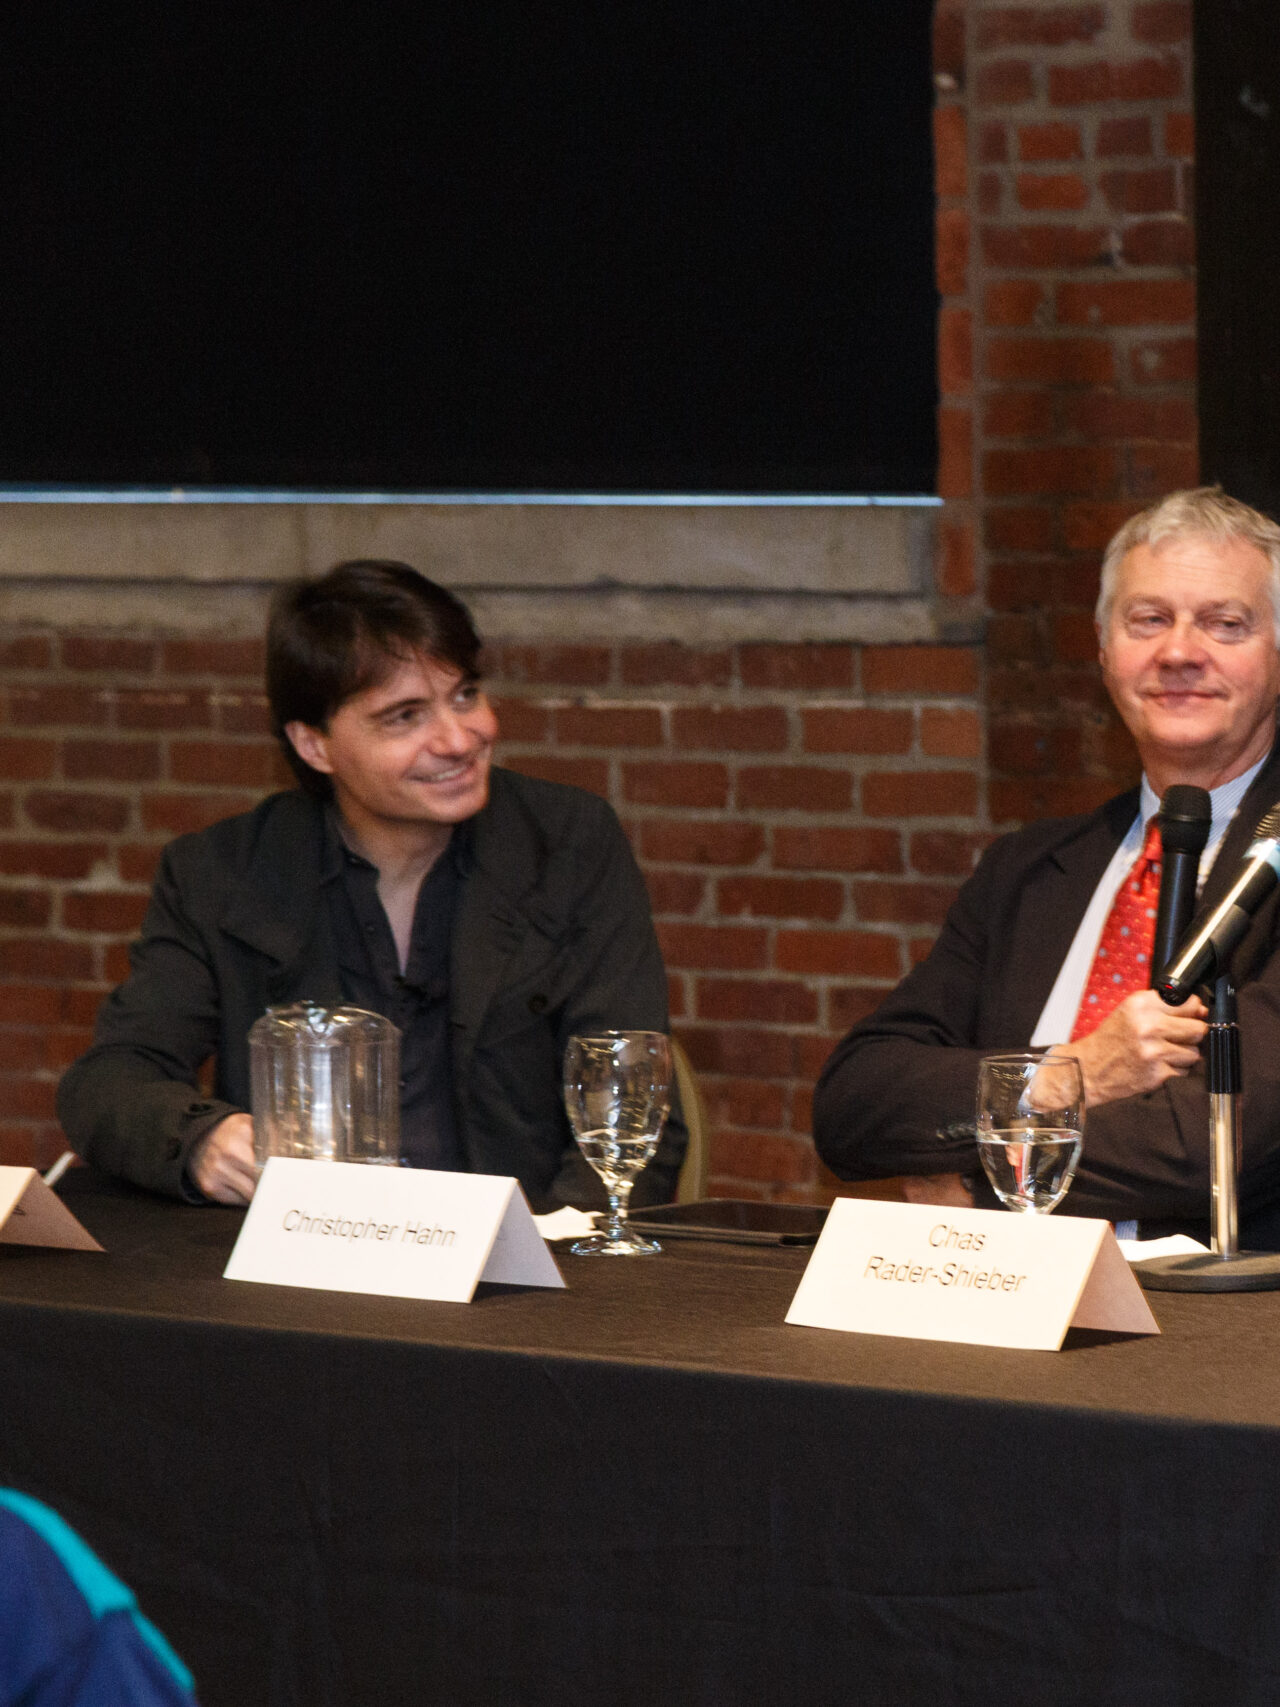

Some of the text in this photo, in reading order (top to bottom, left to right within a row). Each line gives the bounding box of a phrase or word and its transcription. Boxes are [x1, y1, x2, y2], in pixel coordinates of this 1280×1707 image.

[282, 1209, 457, 1247] Christopher Hahn
[928, 1224, 987, 1252] Chas
[863, 1255, 1027, 1293] Rader-Shieber
